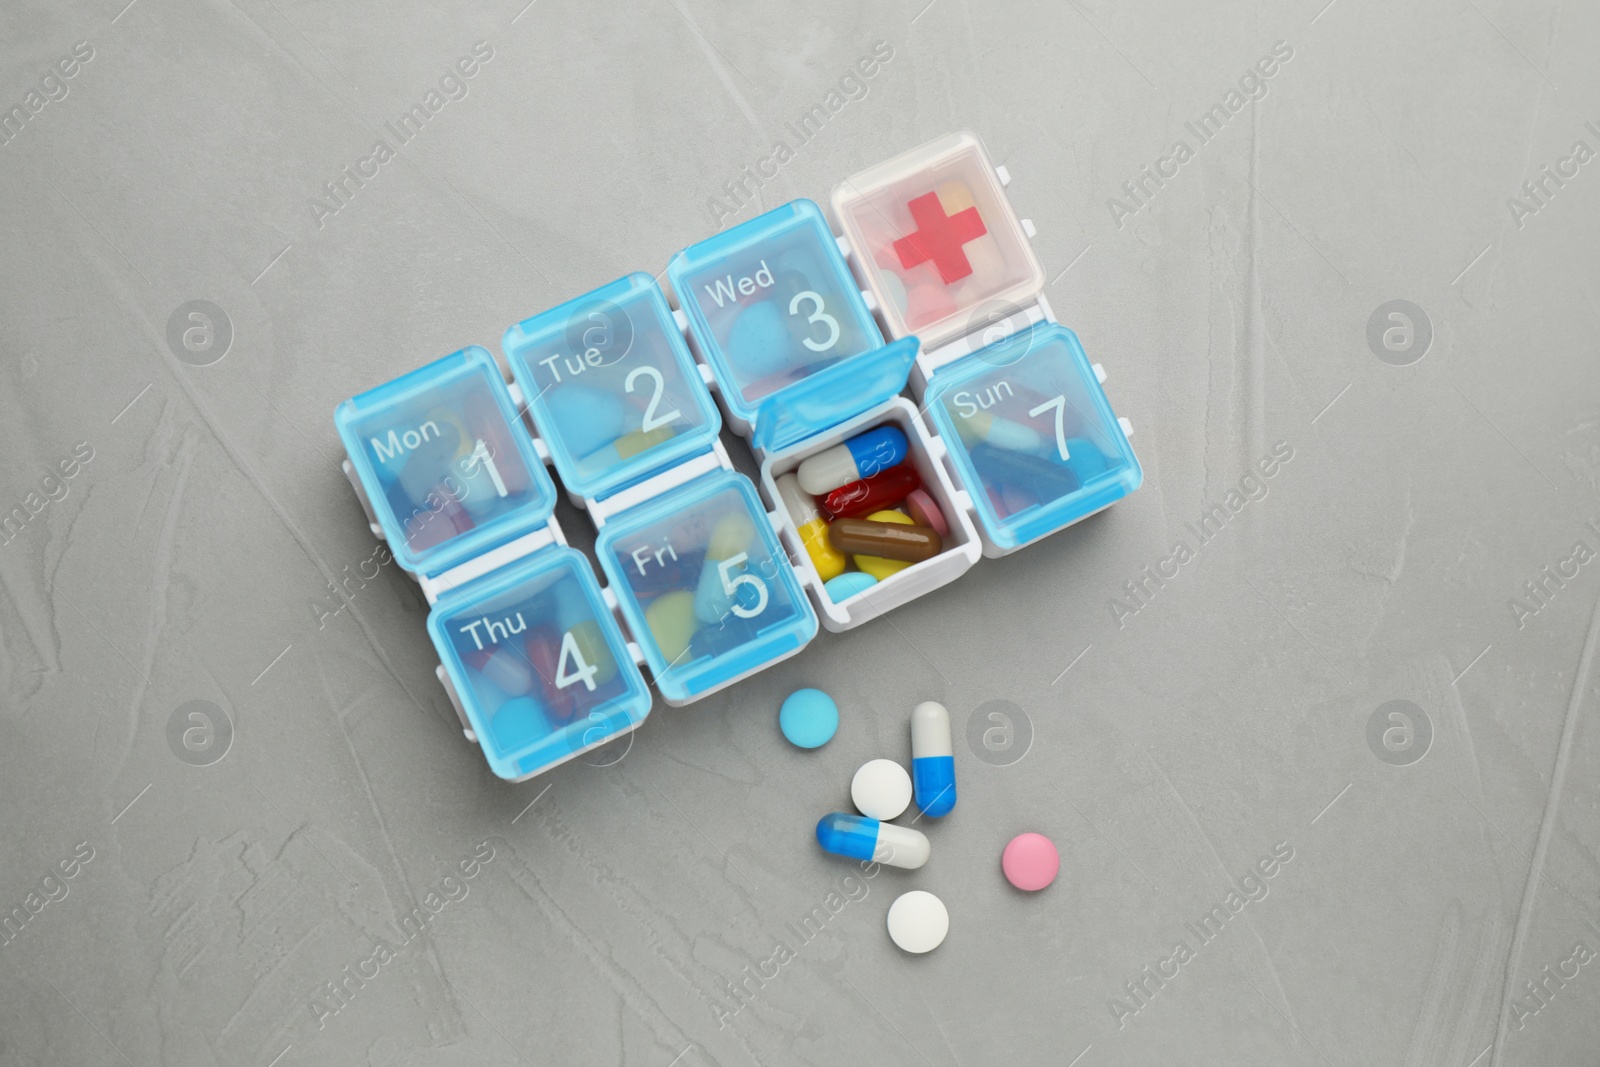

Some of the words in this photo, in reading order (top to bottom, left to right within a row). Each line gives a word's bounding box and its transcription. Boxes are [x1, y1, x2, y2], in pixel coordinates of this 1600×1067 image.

[704, 260, 775, 308] Wed
[789, 291, 840, 351] 3
[539, 348, 602, 383] Tue
[625, 366, 682, 433] 2
[953, 381, 1013, 419] Sun
[370, 420, 441, 463] Mon
[1029, 395, 1070, 461] 7
[465, 439, 508, 498] 1
[631, 537, 678, 576] Fri
[717, 552, 768, 618] 5
[460, 612, 527, 650] Thu
[555, 631, 598, 691] 4
